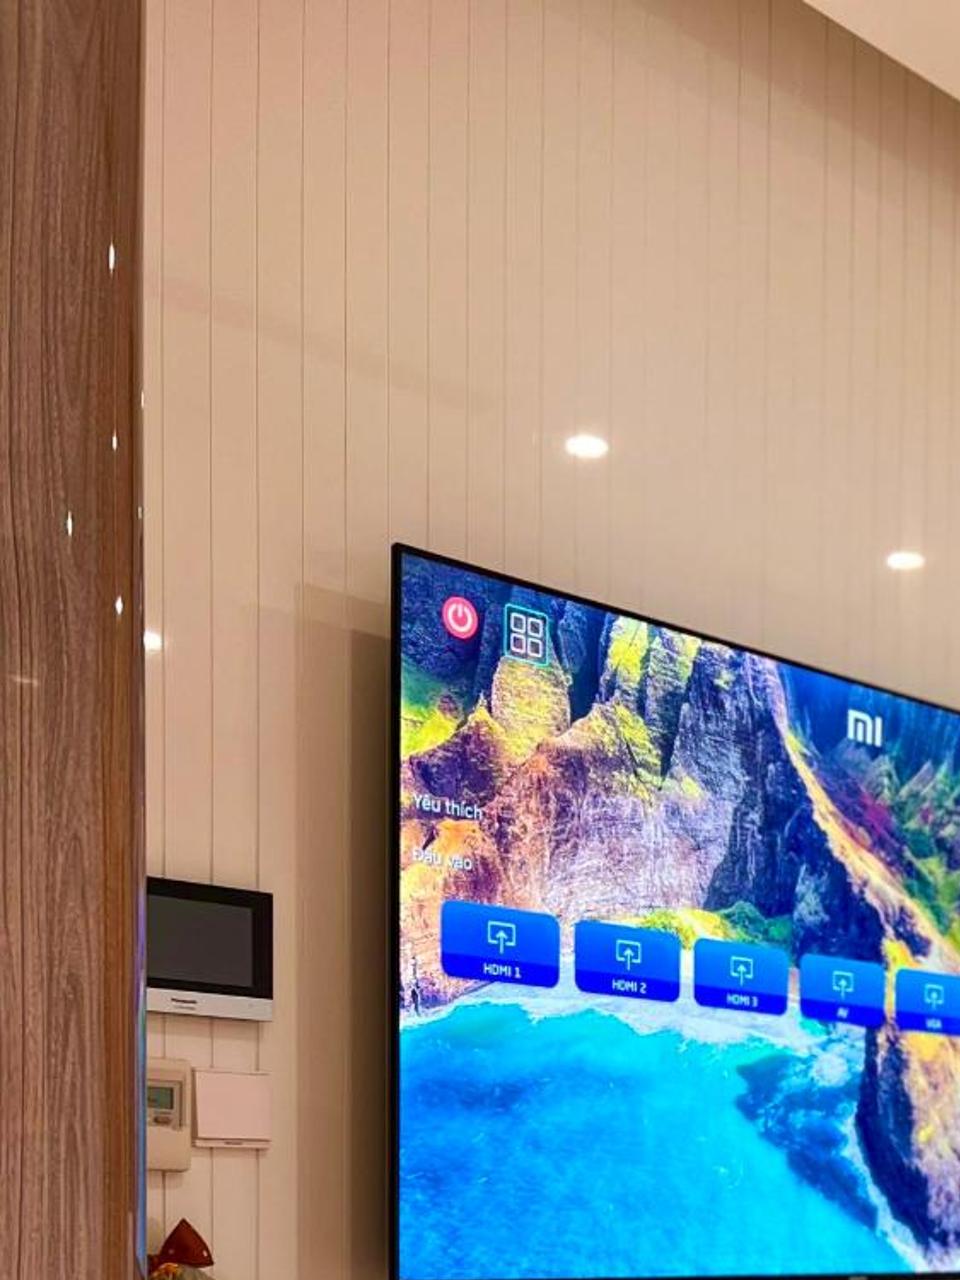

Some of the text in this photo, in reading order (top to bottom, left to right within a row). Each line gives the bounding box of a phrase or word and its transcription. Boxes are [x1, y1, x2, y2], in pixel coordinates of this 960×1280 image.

[413, 794, 482, 820] Yêu thích
[483, 962, 522, 979] HDMI 1
[612, 978, 648, 995] HDMI 2
[726, 992, 750, 1007] HDMI
